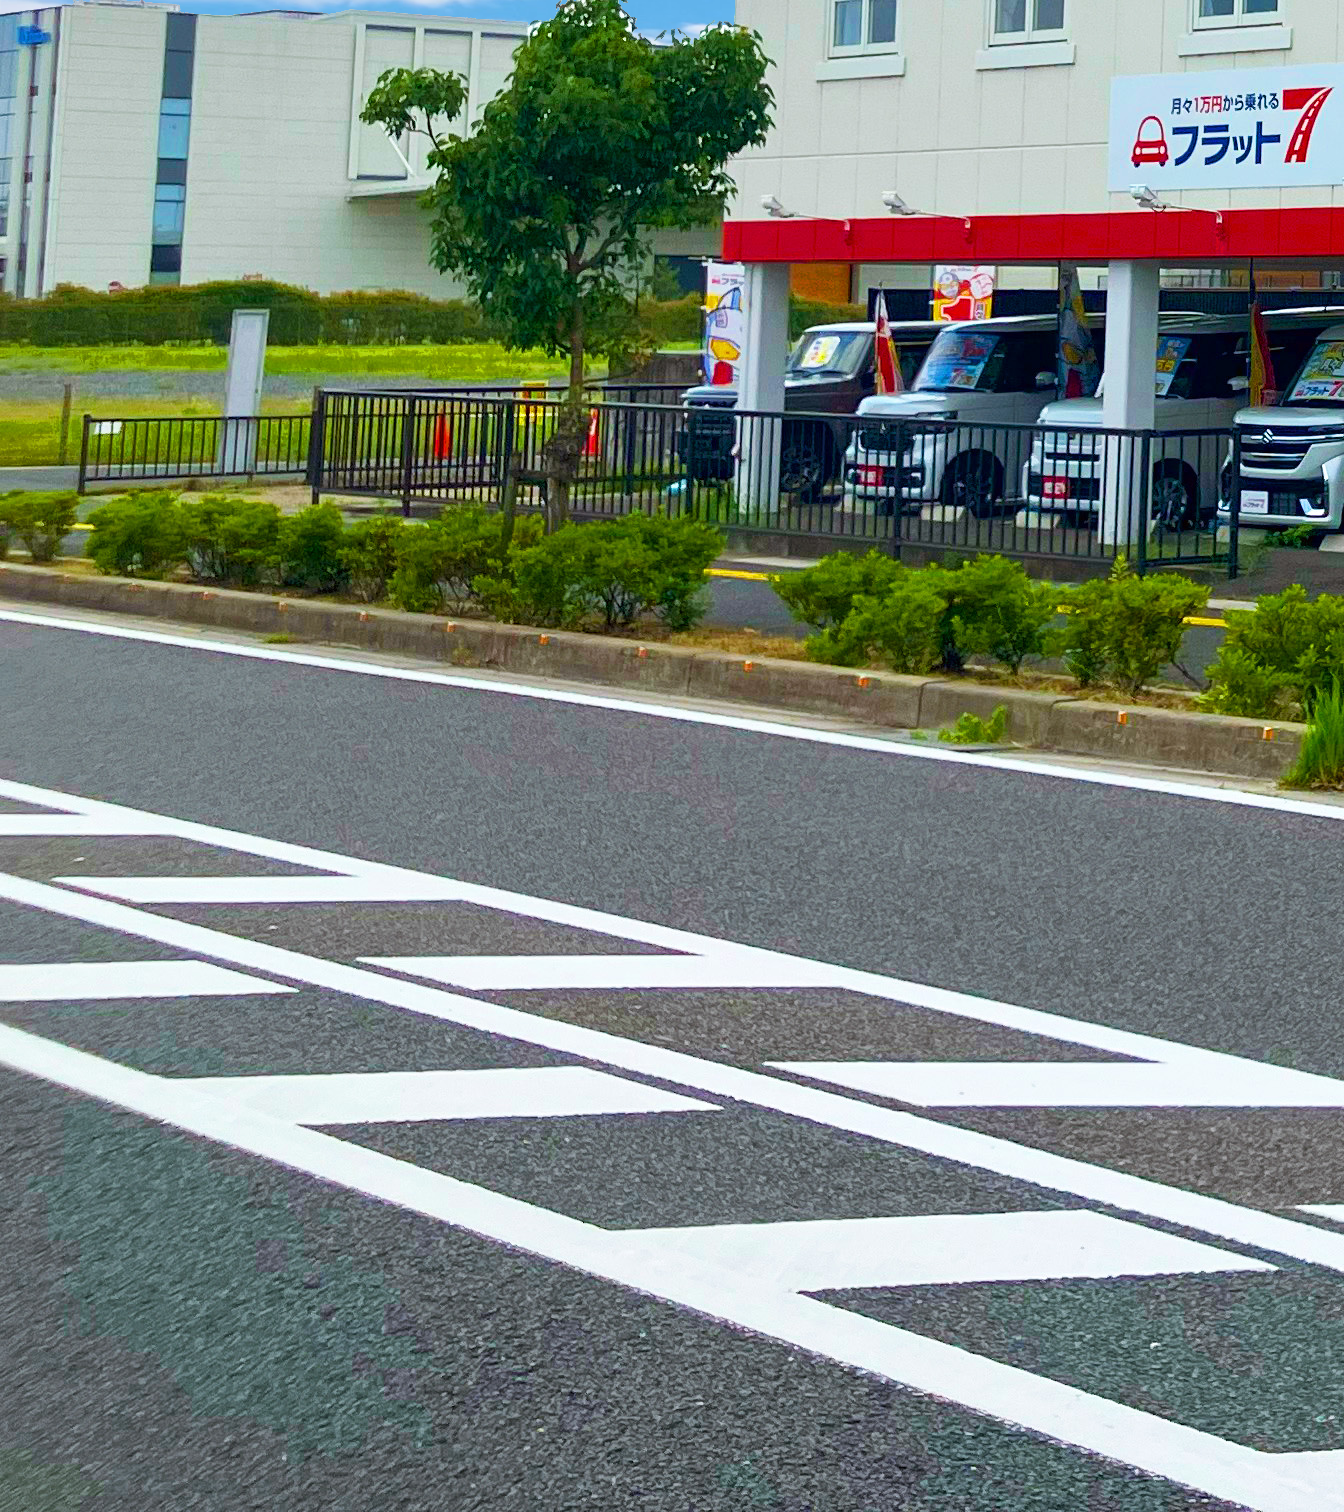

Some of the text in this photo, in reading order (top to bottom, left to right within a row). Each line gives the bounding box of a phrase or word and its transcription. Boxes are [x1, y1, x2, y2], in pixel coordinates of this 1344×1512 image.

[1171, 92, 1279, 115] 月々1万円から乗れる
